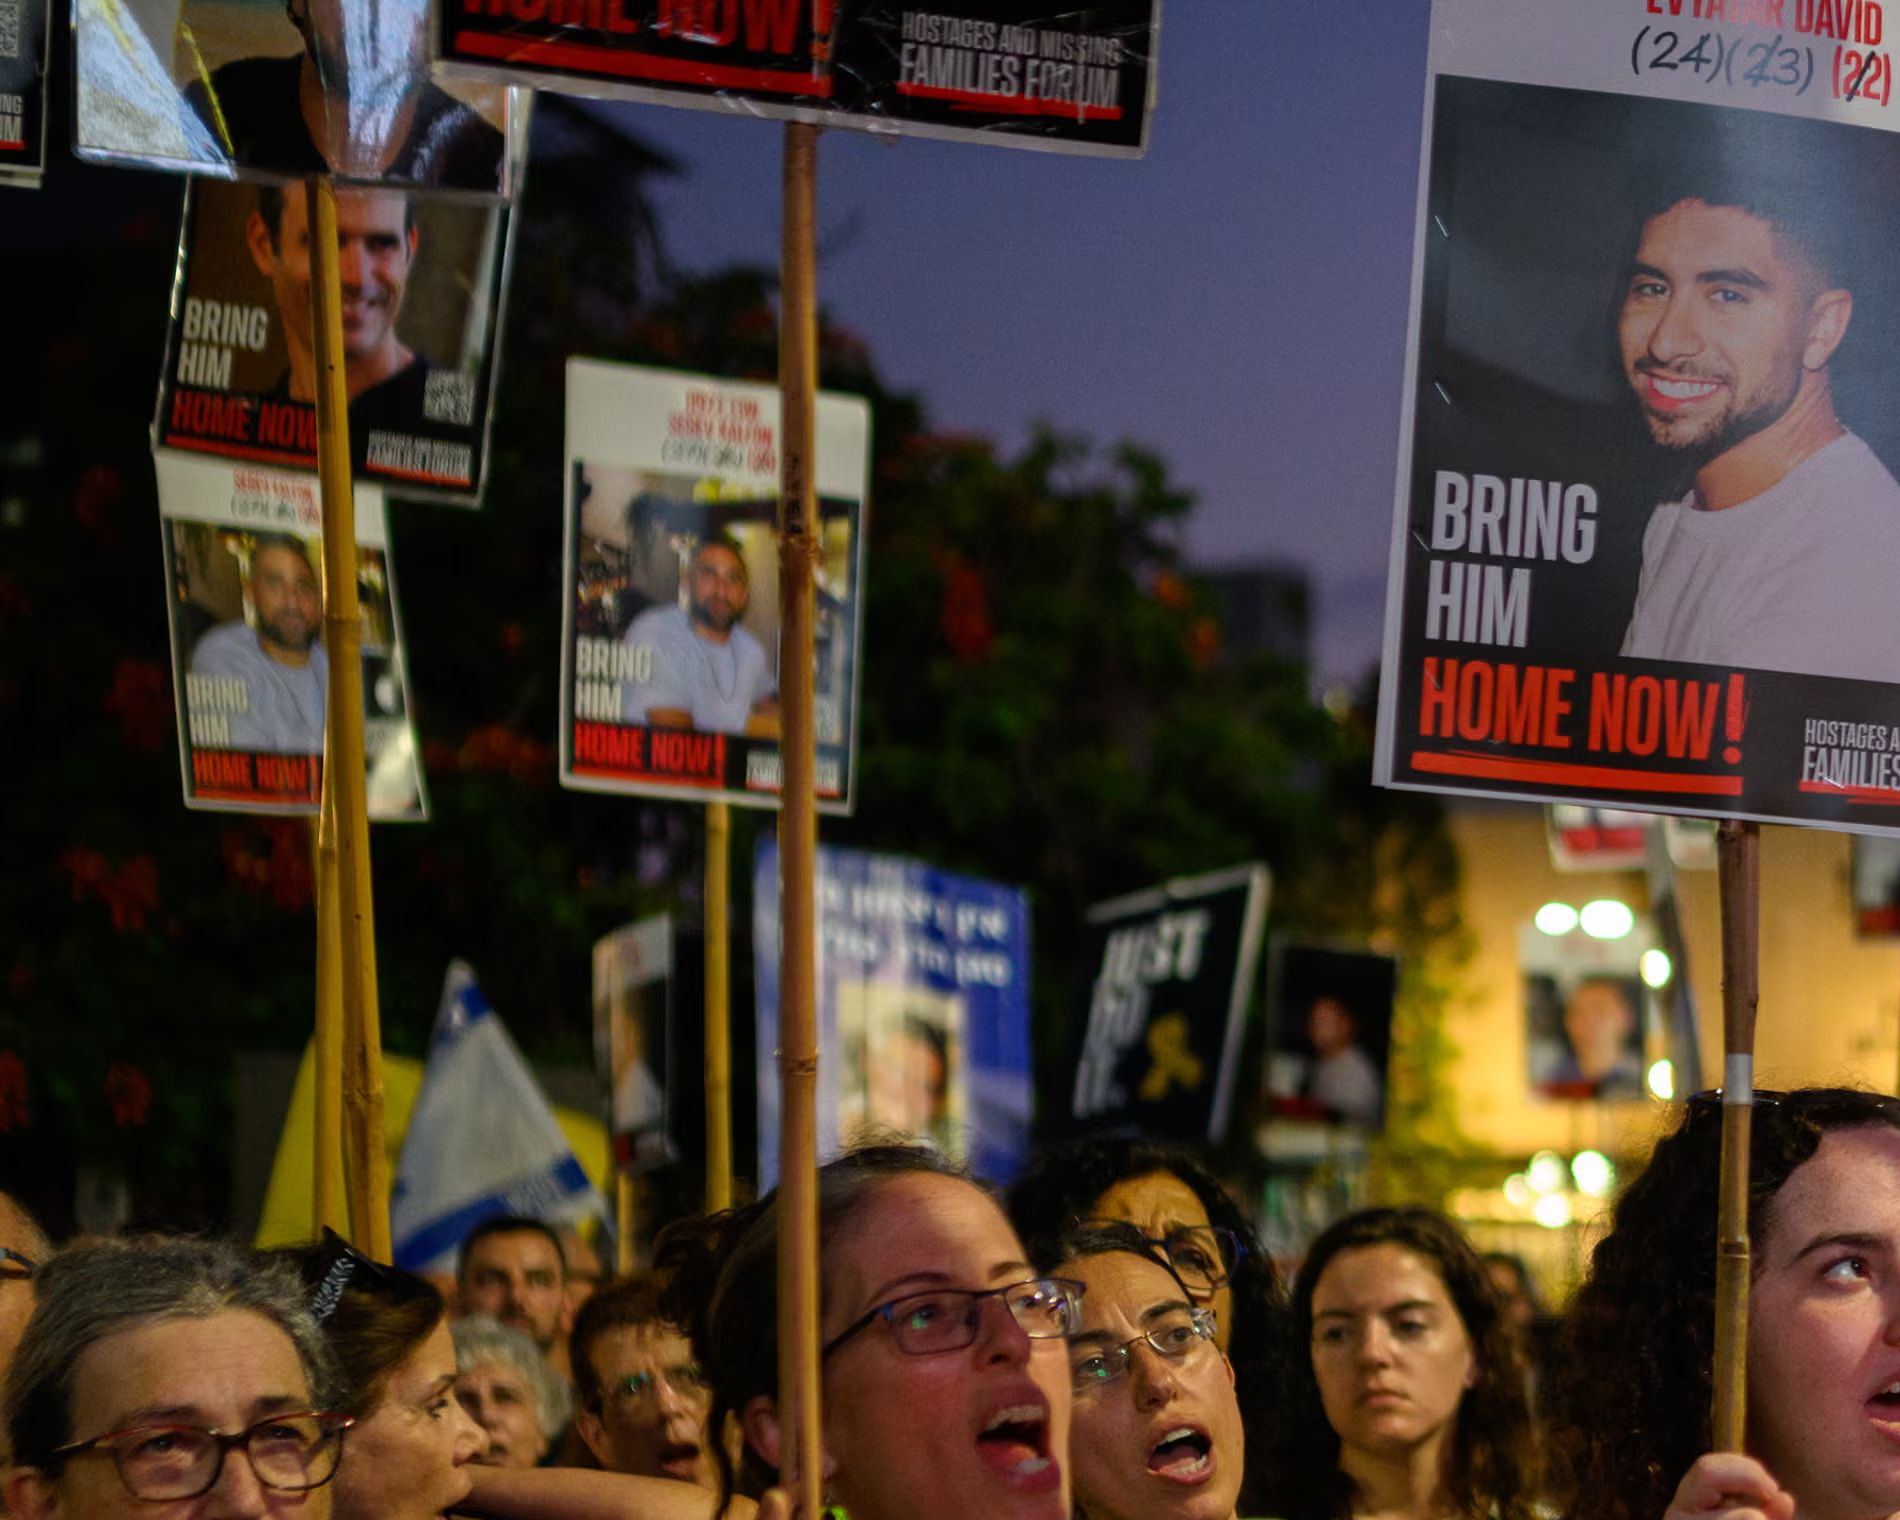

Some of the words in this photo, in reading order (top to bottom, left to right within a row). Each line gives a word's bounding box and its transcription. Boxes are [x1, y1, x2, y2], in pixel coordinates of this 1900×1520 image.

[902, 11, 996, 50] HOSTAGES
[1000, 24, 1036, 55] AND
[1040, 30, 1121, 66] MISSING
[1796, 0, 1882, 45] DAVID
[901, 42, 1019, 98] FAMILIES
[1024, 59, 1120, 108] FORUM
[182, 298, 268, 350] BRING
[177, 344, 233, 390] HIM
[171, 390, 250, 440] HOME
[1431, 470, 1598, 564] BRING
[1425, 559, 1532, 648] HIM
[575, 637, 652, 685] BRING
[574, 682, 622, 721] HIM
[1419, 656, 1576, 748] HOME
[1587, 672, 1745, 765] NOW!
[189, 712, 230, 748] HIM
[573, 722, 644, 767] HOME
[649, 731, 726, 779] NOW!
[1804, 719, 1887, 750] HOSTAGES
[192, 751, 251, 791] HOME
